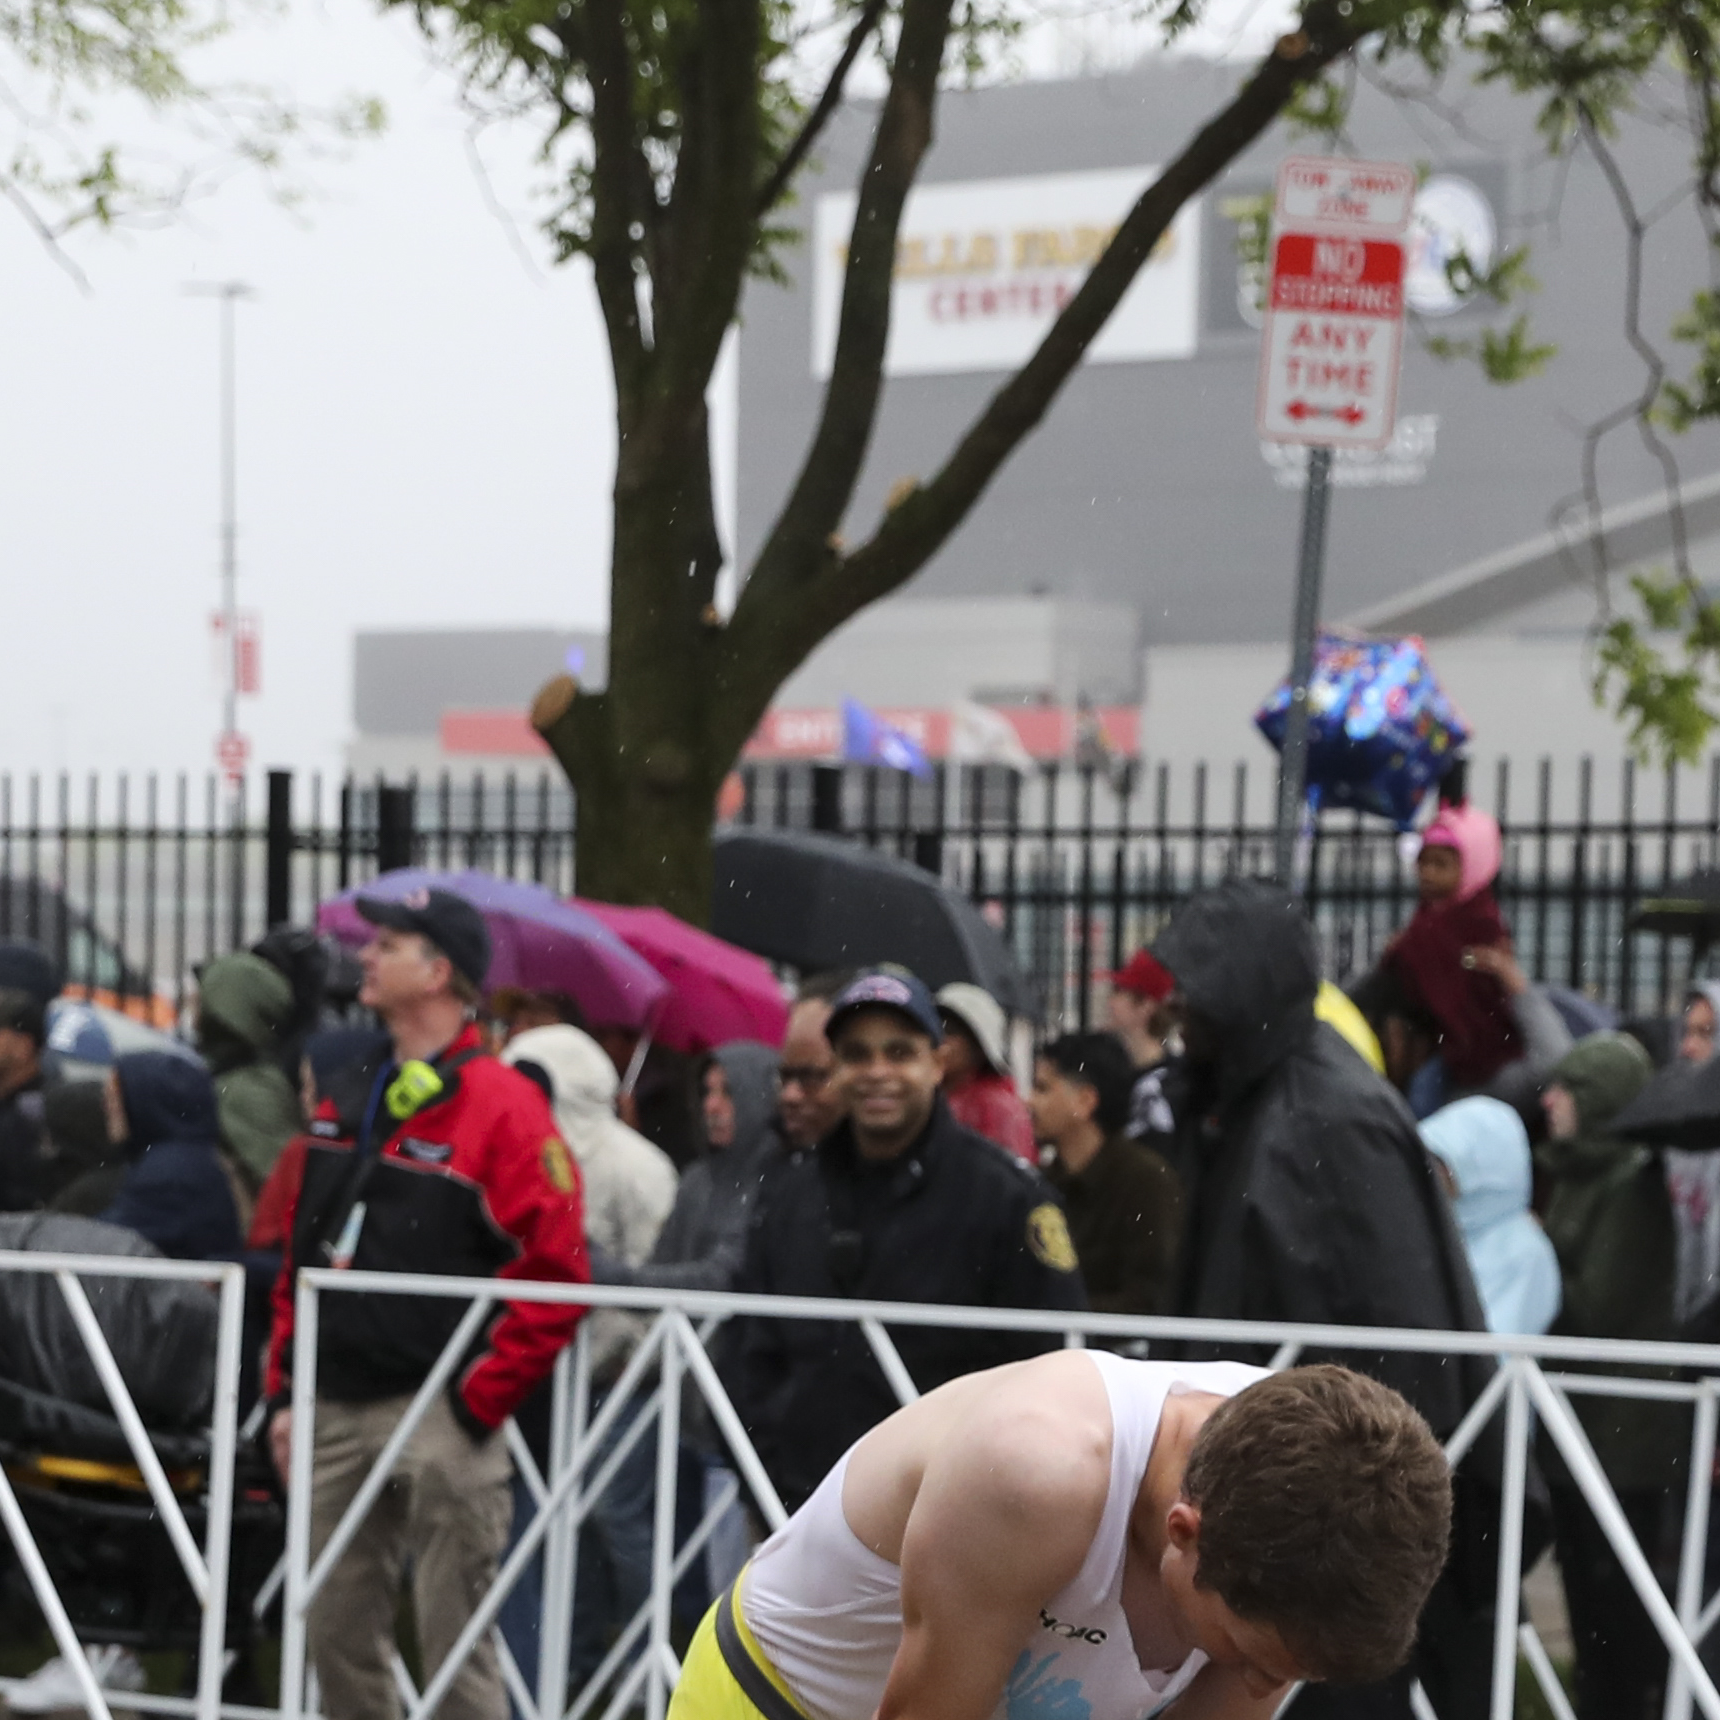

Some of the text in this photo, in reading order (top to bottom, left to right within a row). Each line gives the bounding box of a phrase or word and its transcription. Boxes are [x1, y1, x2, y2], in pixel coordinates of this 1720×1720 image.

[1313, 241, 1366, 283] NO
[1275, 277, 1400, 312] STOPPING
[1289, 322, 1375, 354] ANY
[1285, 356, 1375, 397] TIME
